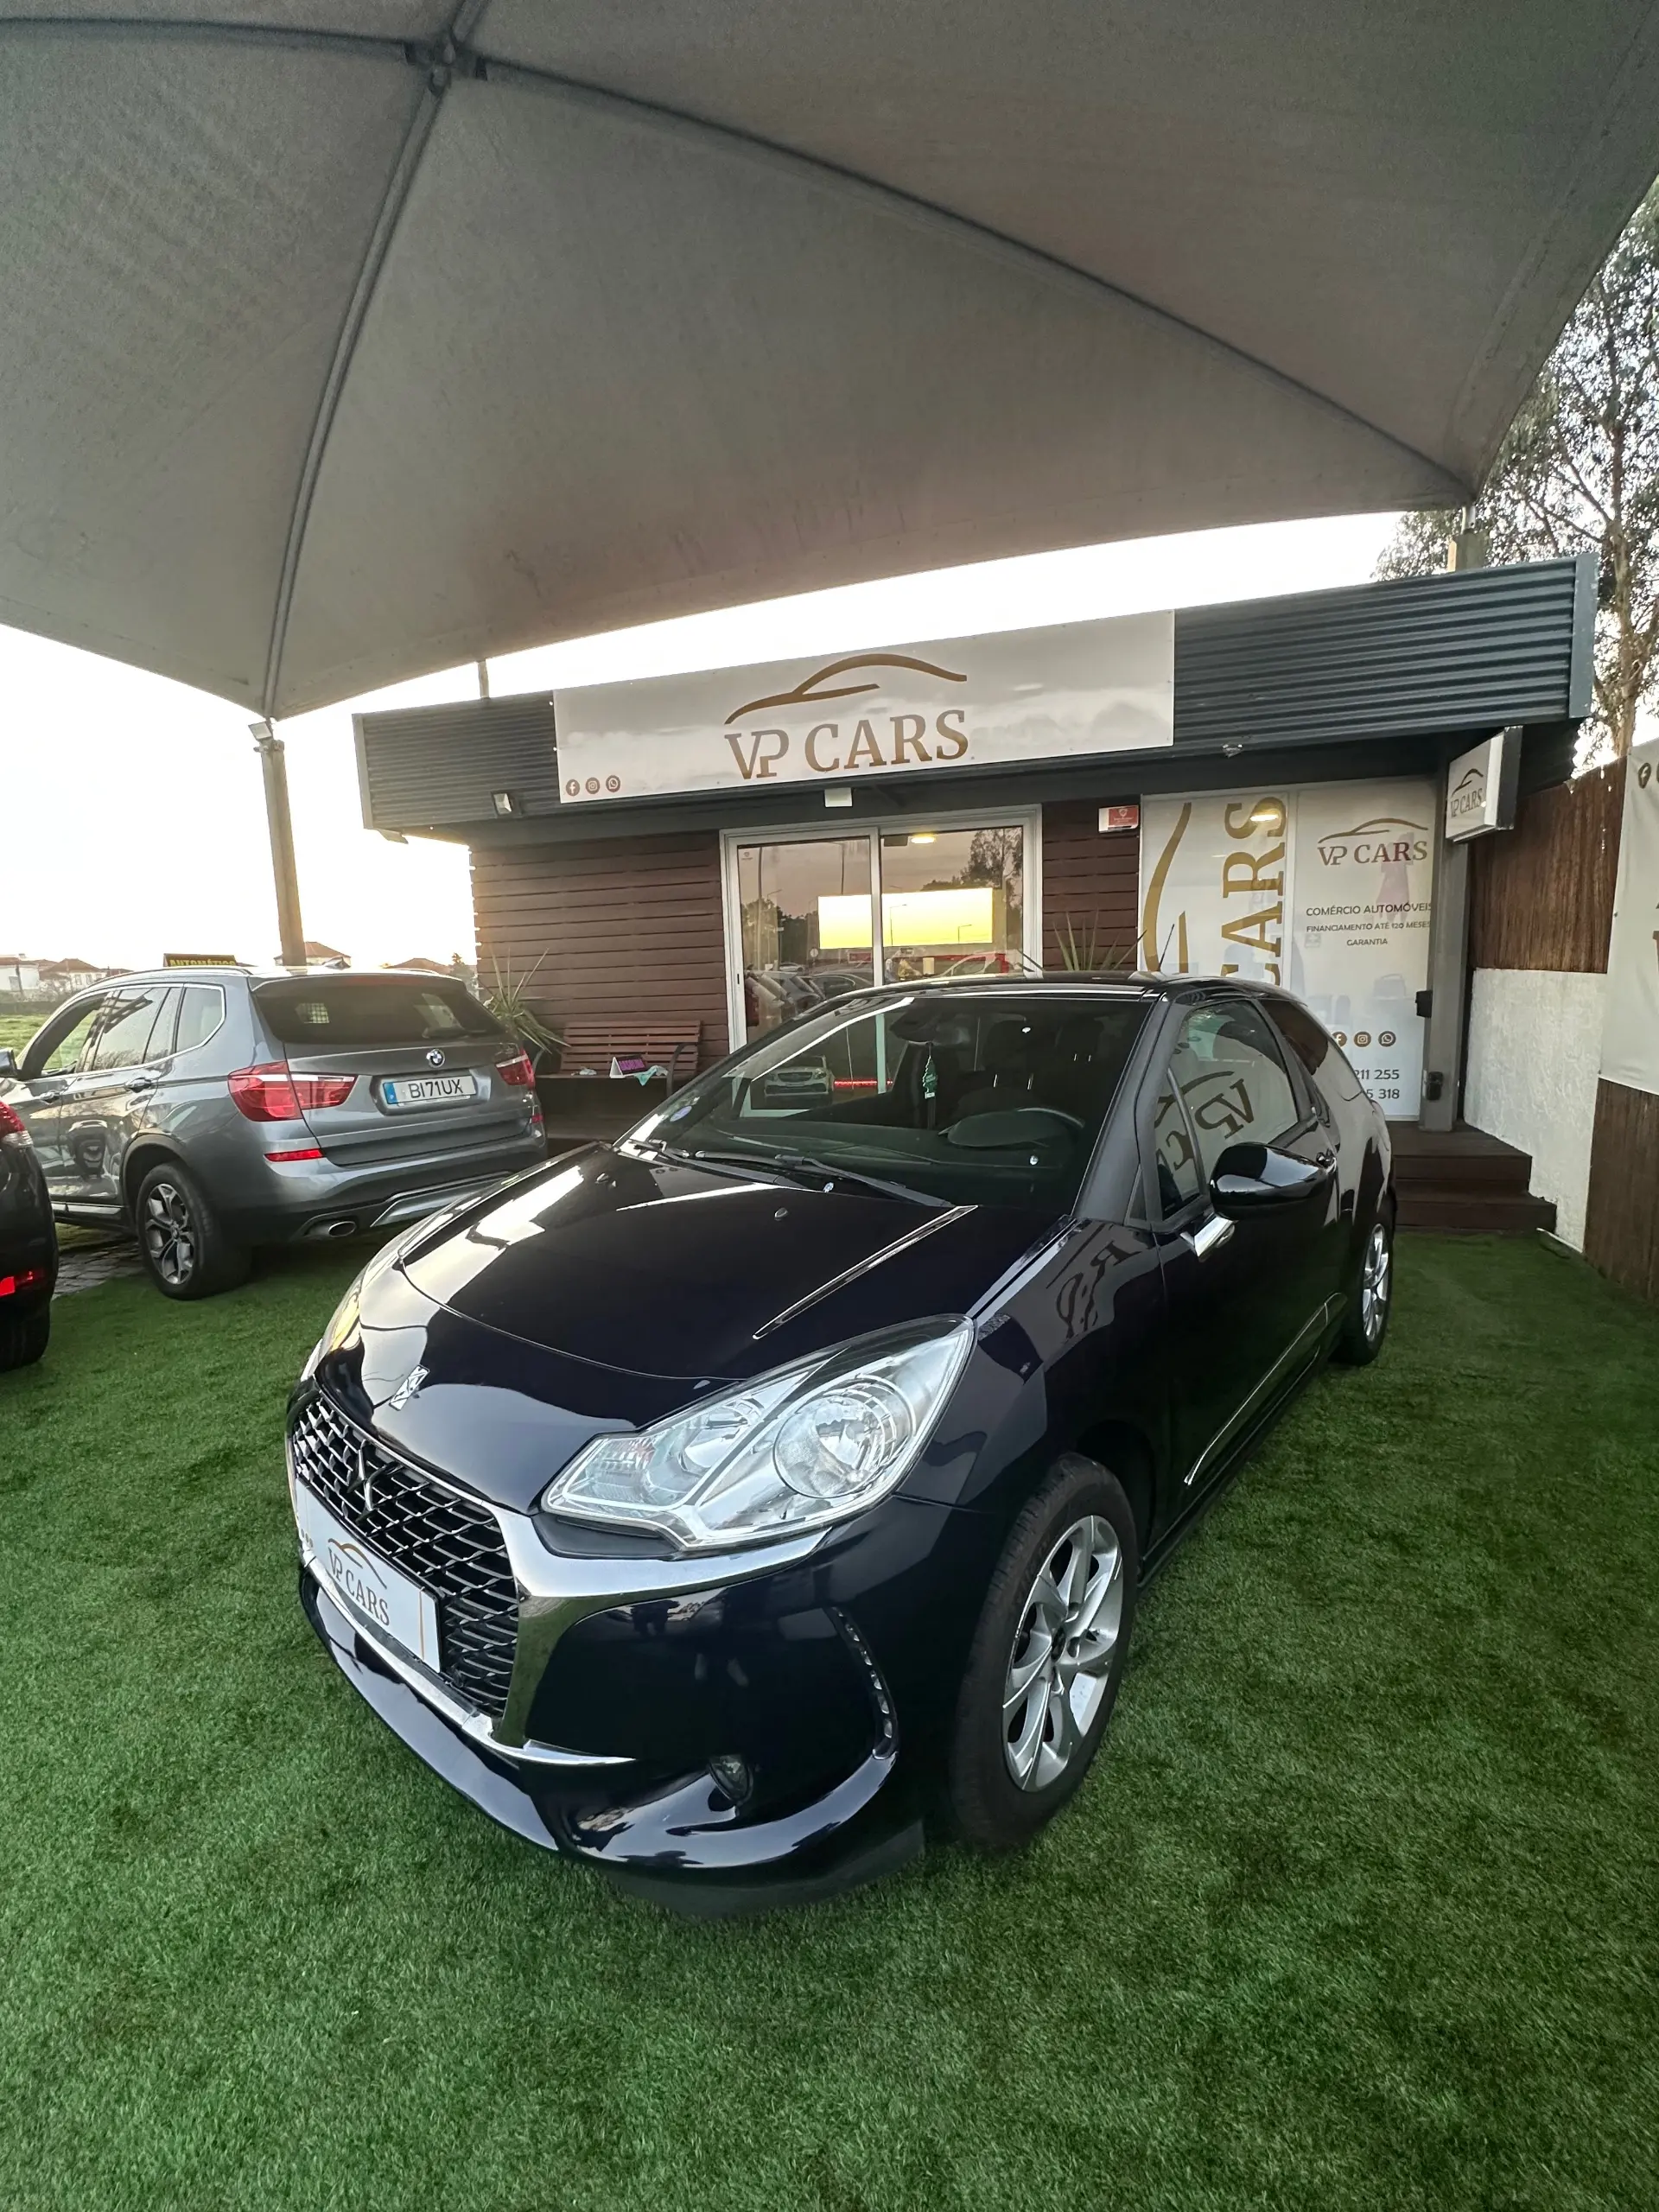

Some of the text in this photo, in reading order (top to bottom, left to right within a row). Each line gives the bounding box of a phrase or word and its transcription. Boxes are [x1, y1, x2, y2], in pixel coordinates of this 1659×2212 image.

[724, 709, 969, 780] VP CARS
[1460, 787, 1483, 814] CARS
[1317, 841, 1427, 866] VP CARS
[1306, 905, 1361, 917] COMÉRCIO
[1306, 923, 1373, 932] FINANCIAMENTO
[1375, 921, 1389, 930] ATÉ
[1374, 1069, 1400, 1080] 255
[408, 1079, 464, 1098] BI71UX
[1377, 1089, 1400, 1099] 318
[327, 1547, 390, 1626] VP CARS
